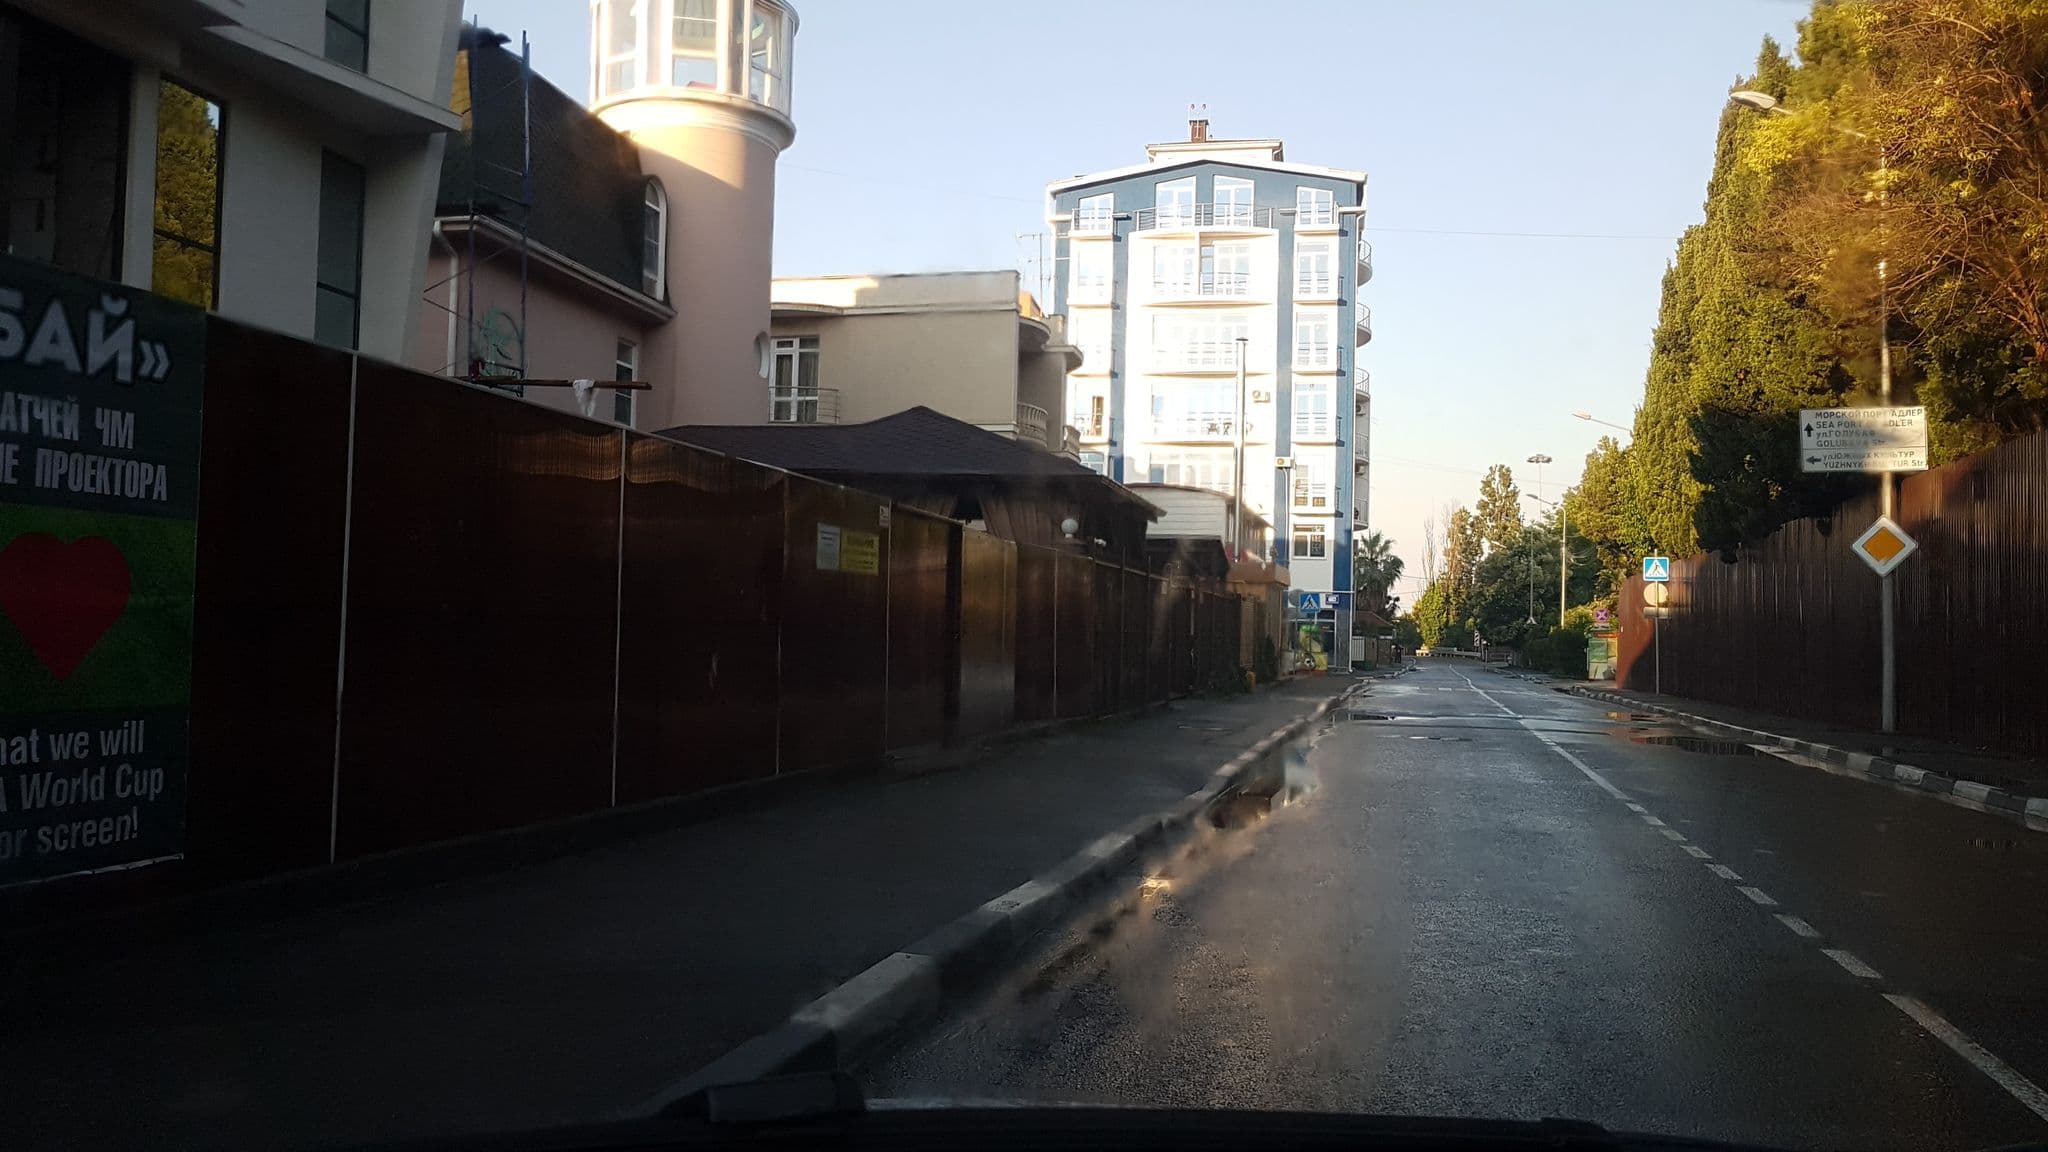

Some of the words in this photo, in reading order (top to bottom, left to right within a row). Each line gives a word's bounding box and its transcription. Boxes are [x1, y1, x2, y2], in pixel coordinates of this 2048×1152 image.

[95, 407, 136, 449] ЧМ
[1815, 410, 1862, 419] МОРСКОЙ
[1891, 408, 1923, 417] АДЛЕР
[1815, 420, 1835, 429] SEA
[1883, 419, 1913, 428] DLER
[35, 448, 168, 502] ПРОЕКТОРА
[1873, 450, 1915, 459] КЬТУР
[49, 731, 90, 761] we
[100, 720, 145, 757] will
[20, 766, 106, 810] World
[115, 763, 164, 802] Cup
[37, 806, 138, 855] screen!
